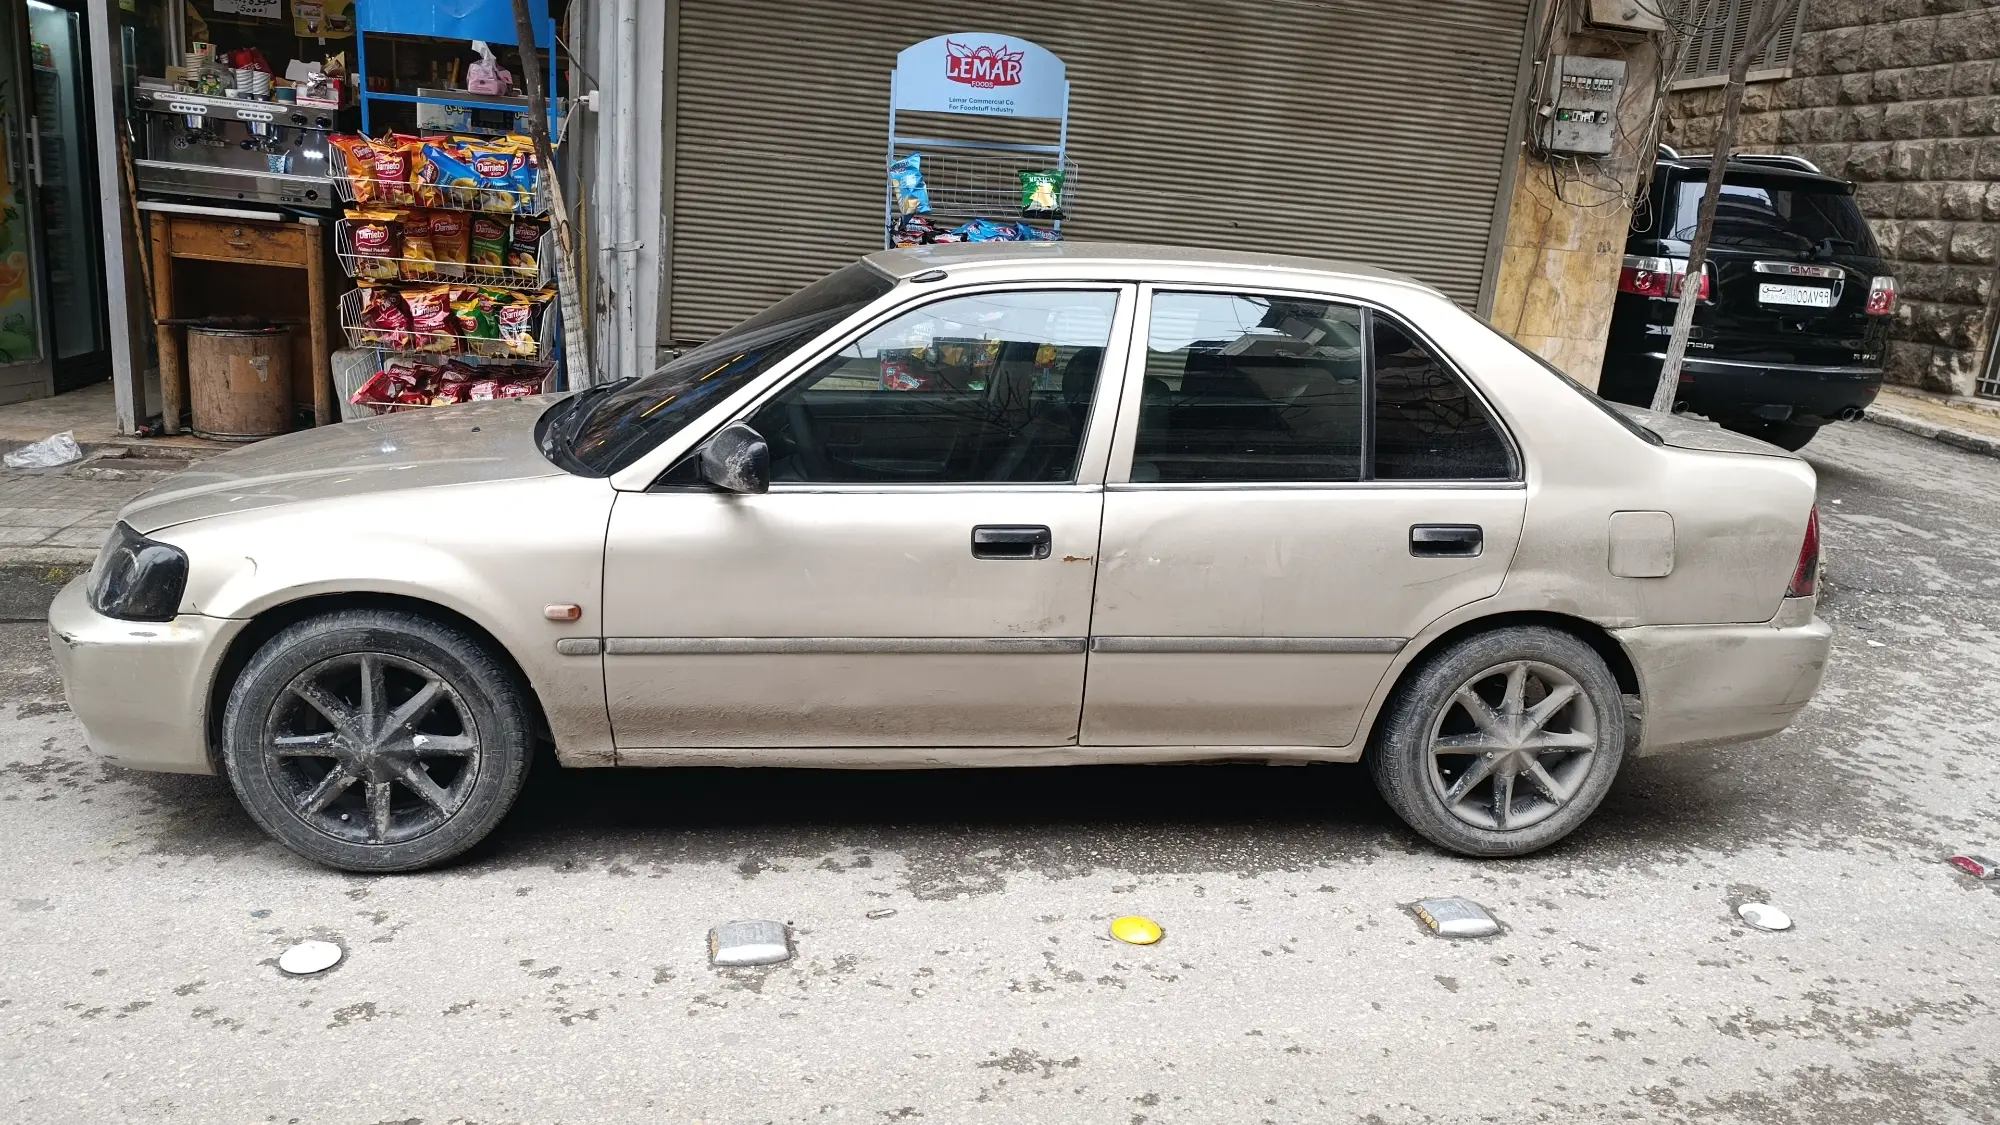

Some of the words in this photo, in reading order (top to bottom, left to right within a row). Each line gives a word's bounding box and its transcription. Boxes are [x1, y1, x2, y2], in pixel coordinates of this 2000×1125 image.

[946, 56, 1020, 83] LEMAR
[971, 80, 994, 88] FOODS
[960, 104, 989, 112] Foodstuff
[990, 106, 1014, 114] Industry
[1790, 265, 1822, 275] GMC
